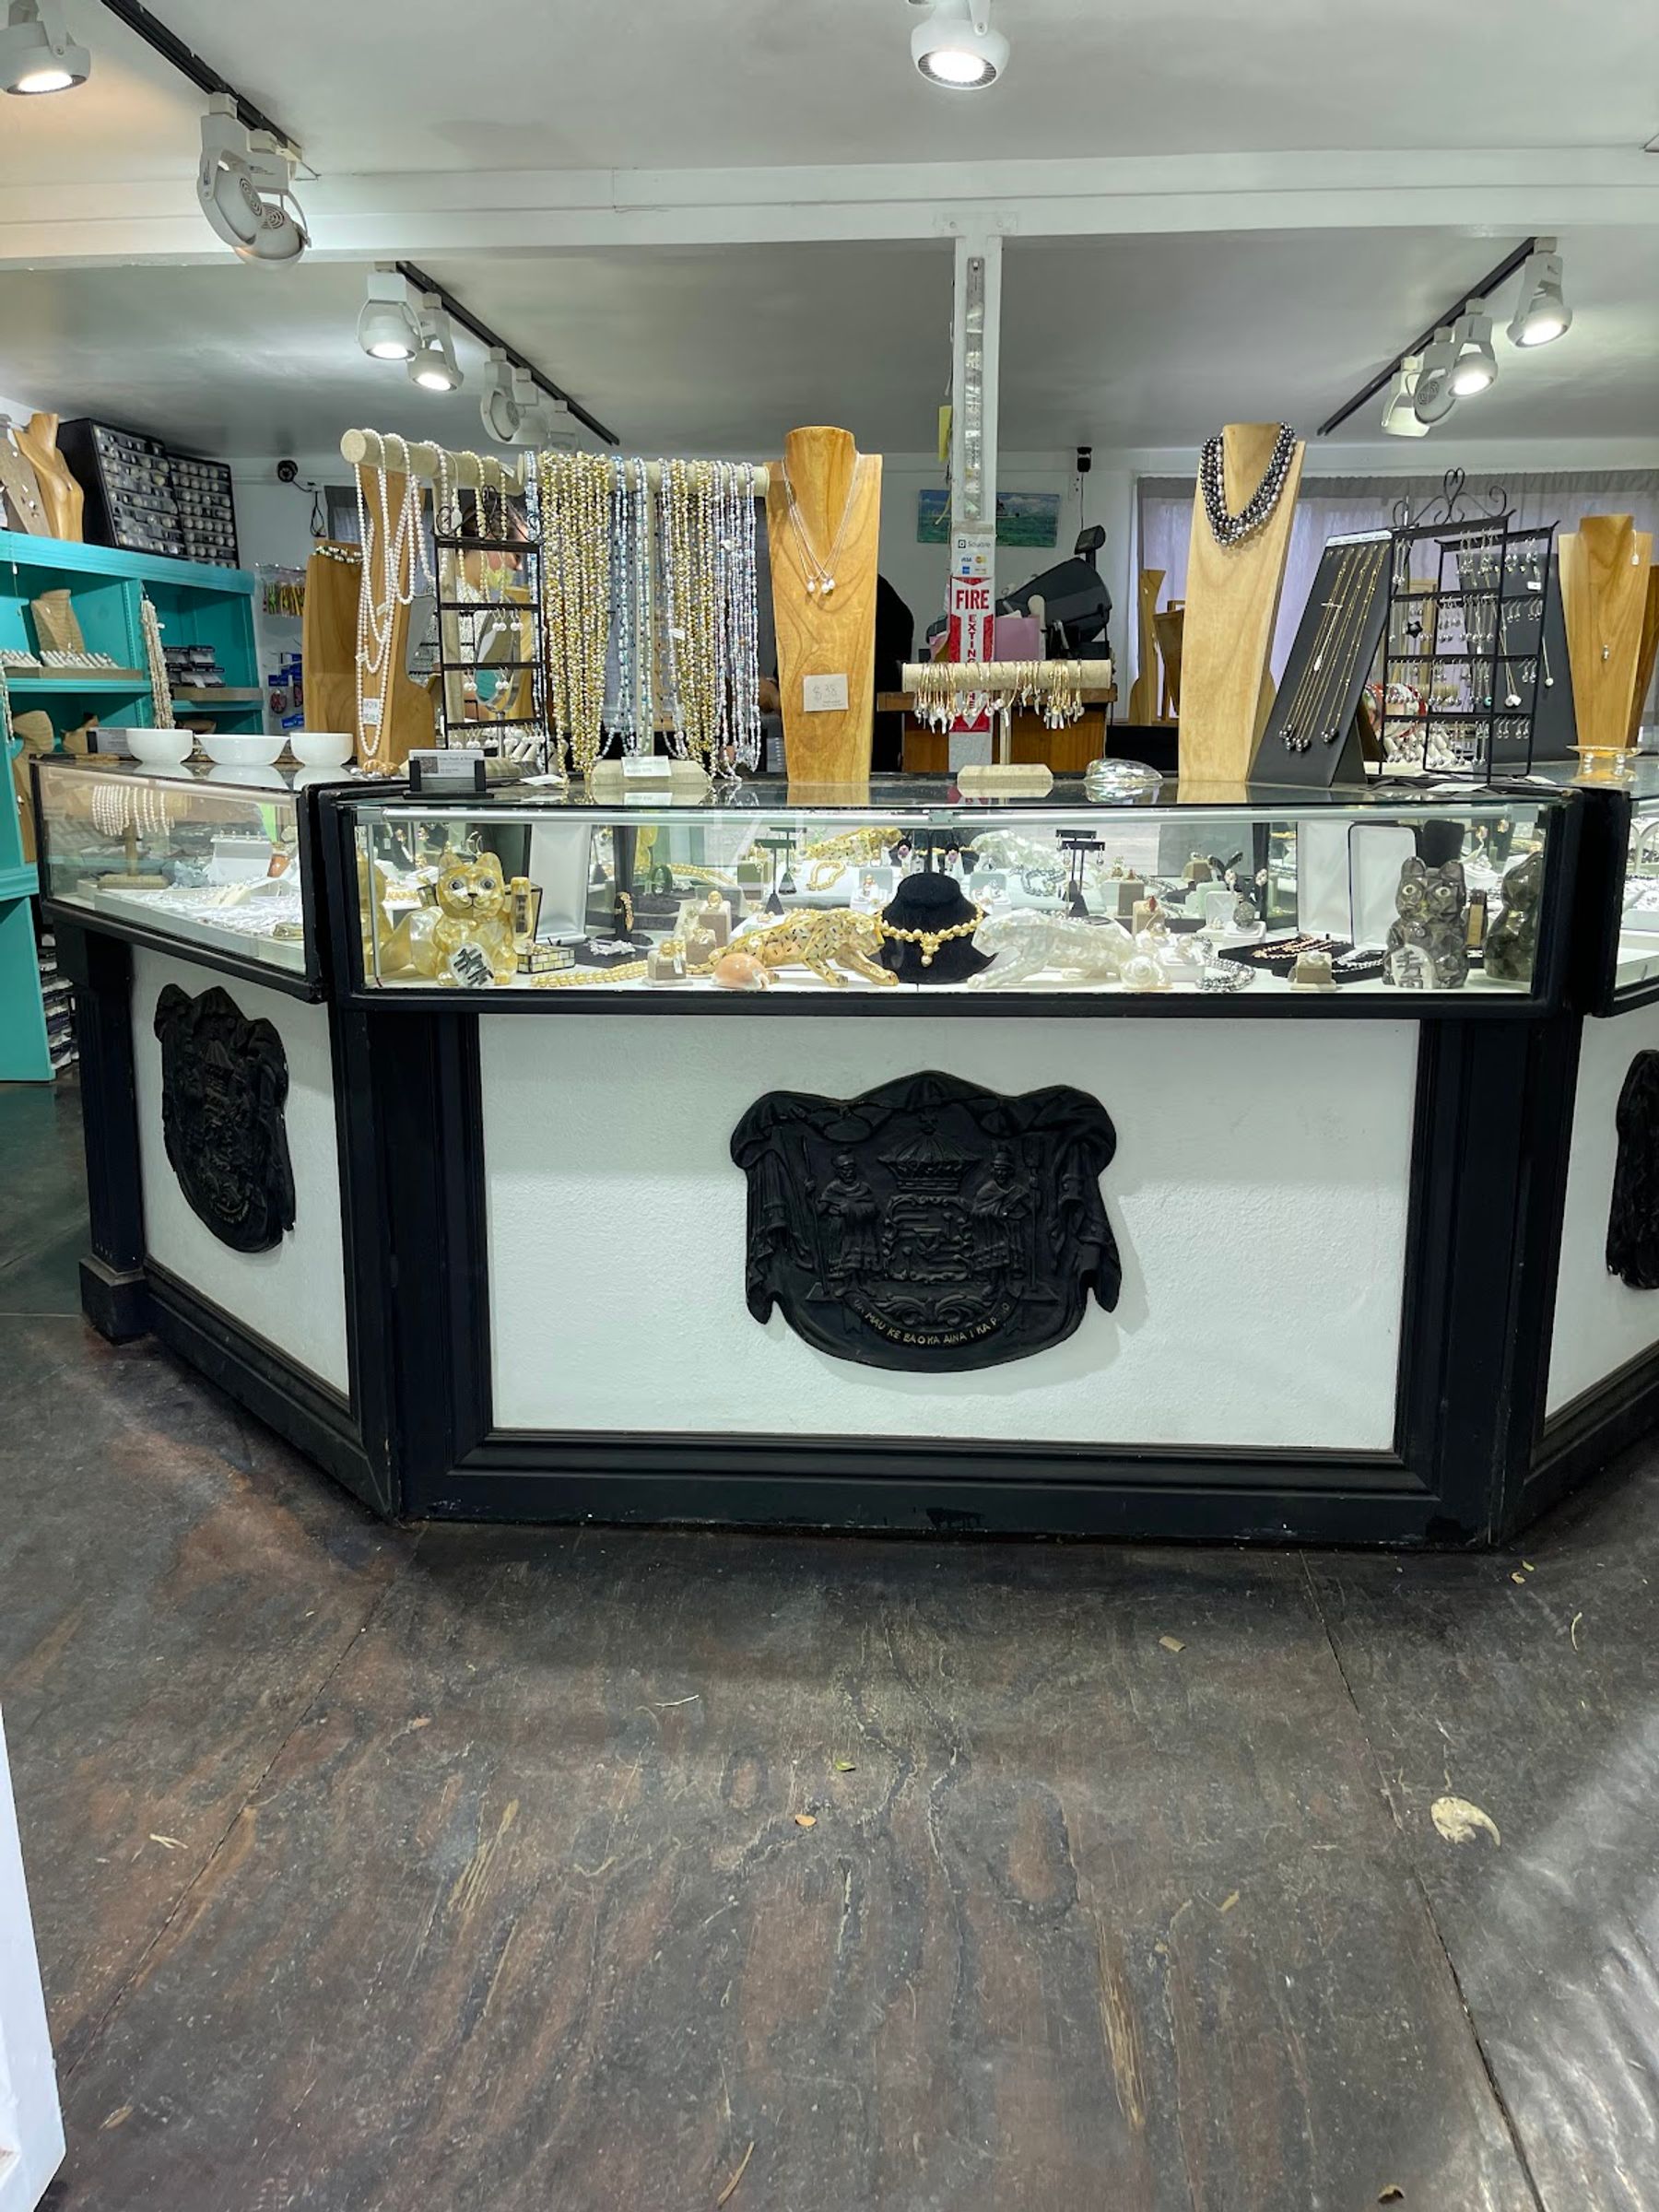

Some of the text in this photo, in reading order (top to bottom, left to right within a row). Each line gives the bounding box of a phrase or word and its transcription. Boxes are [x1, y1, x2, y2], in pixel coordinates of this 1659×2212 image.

[956, 590, 989, 610] FIRE
[865, 1312, 886, 1330] MAU
[943, 1331, 968, 1344] AINA
